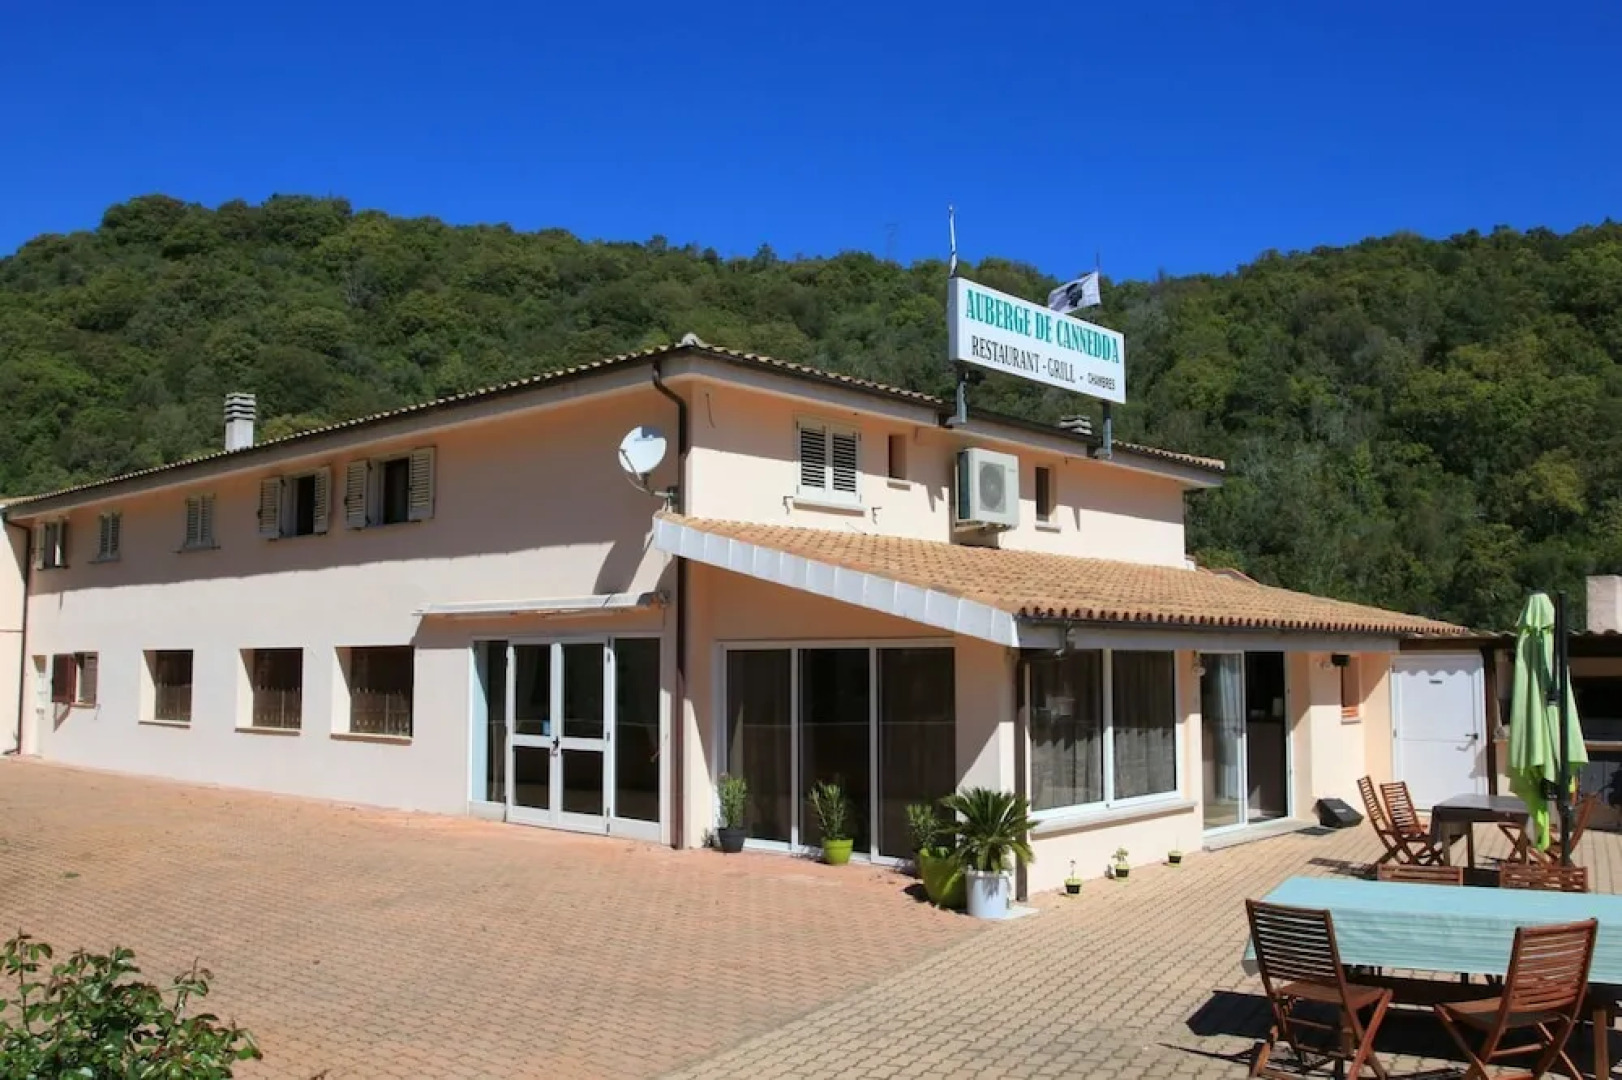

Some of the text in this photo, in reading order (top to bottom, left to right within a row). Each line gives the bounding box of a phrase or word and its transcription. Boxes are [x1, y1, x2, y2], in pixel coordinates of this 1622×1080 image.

[966, 289, 1119, 364] AUBERGE DE CANNEDDA
[971, 335, 1040, 373] RESTAURANT
[1048, 357, 1075, 383] GRILL
